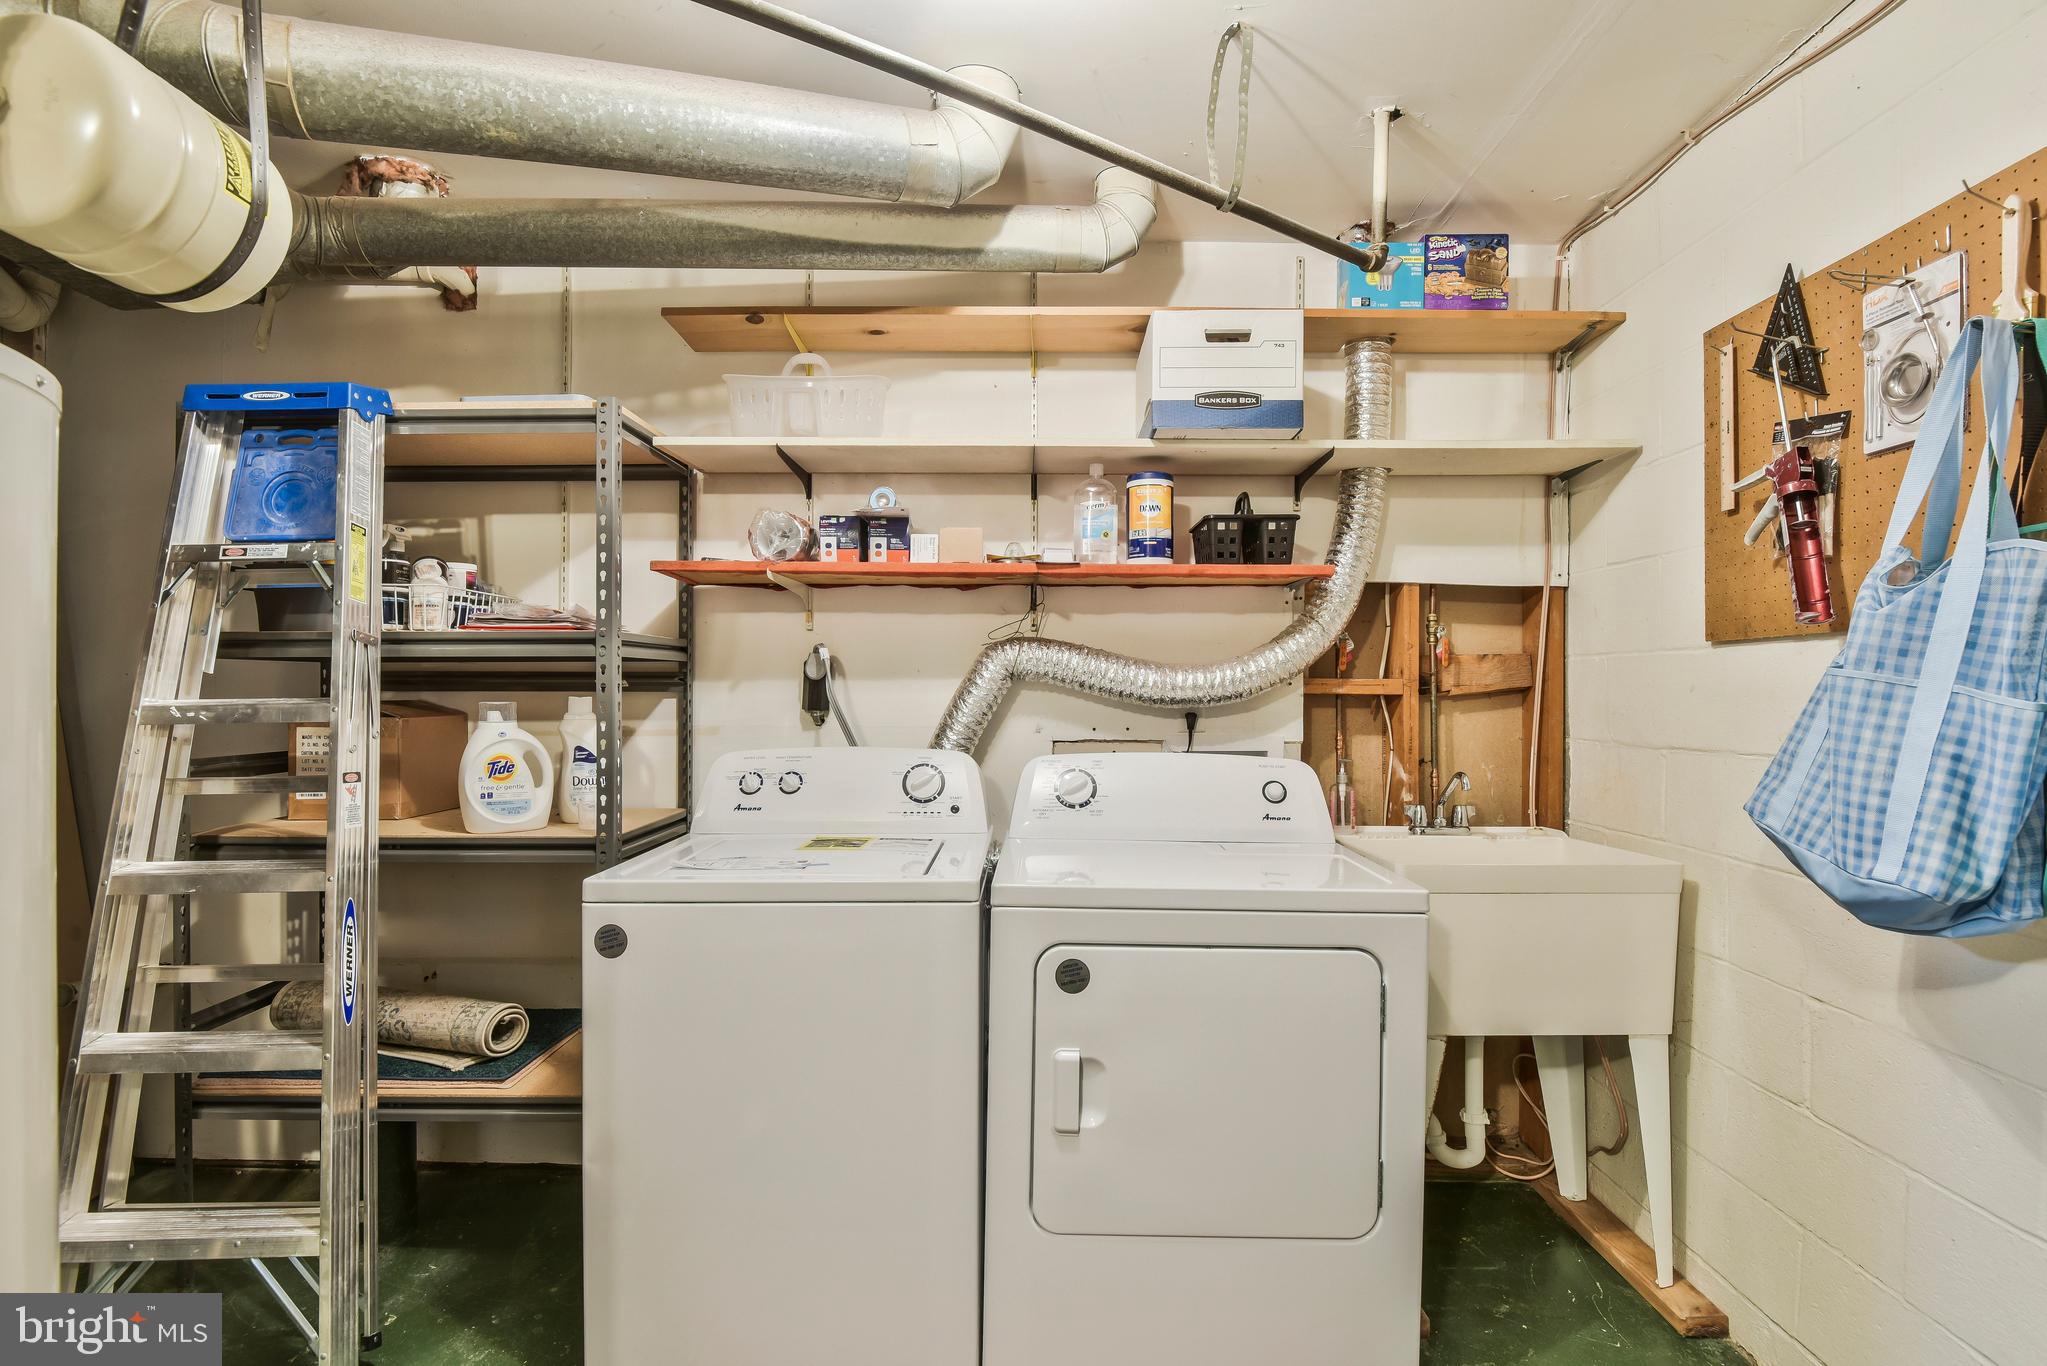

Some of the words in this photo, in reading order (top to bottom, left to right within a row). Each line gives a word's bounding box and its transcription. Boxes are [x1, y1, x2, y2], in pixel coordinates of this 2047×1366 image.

[1428, 238, 1458, 249] Kinetic
[1198, 396, 1238, 404] BANKERS
[1239, 396, 1258, 404] BOX
[487, 760, 515, 779] Tide
[496, 784, 503, 792] &
[503, 783, 525, 791] gentle
[733, 803, 762, 812] Amana
[1262, 813, 1292, 821] Amana
[345, 925, 353, 997] WERNER
